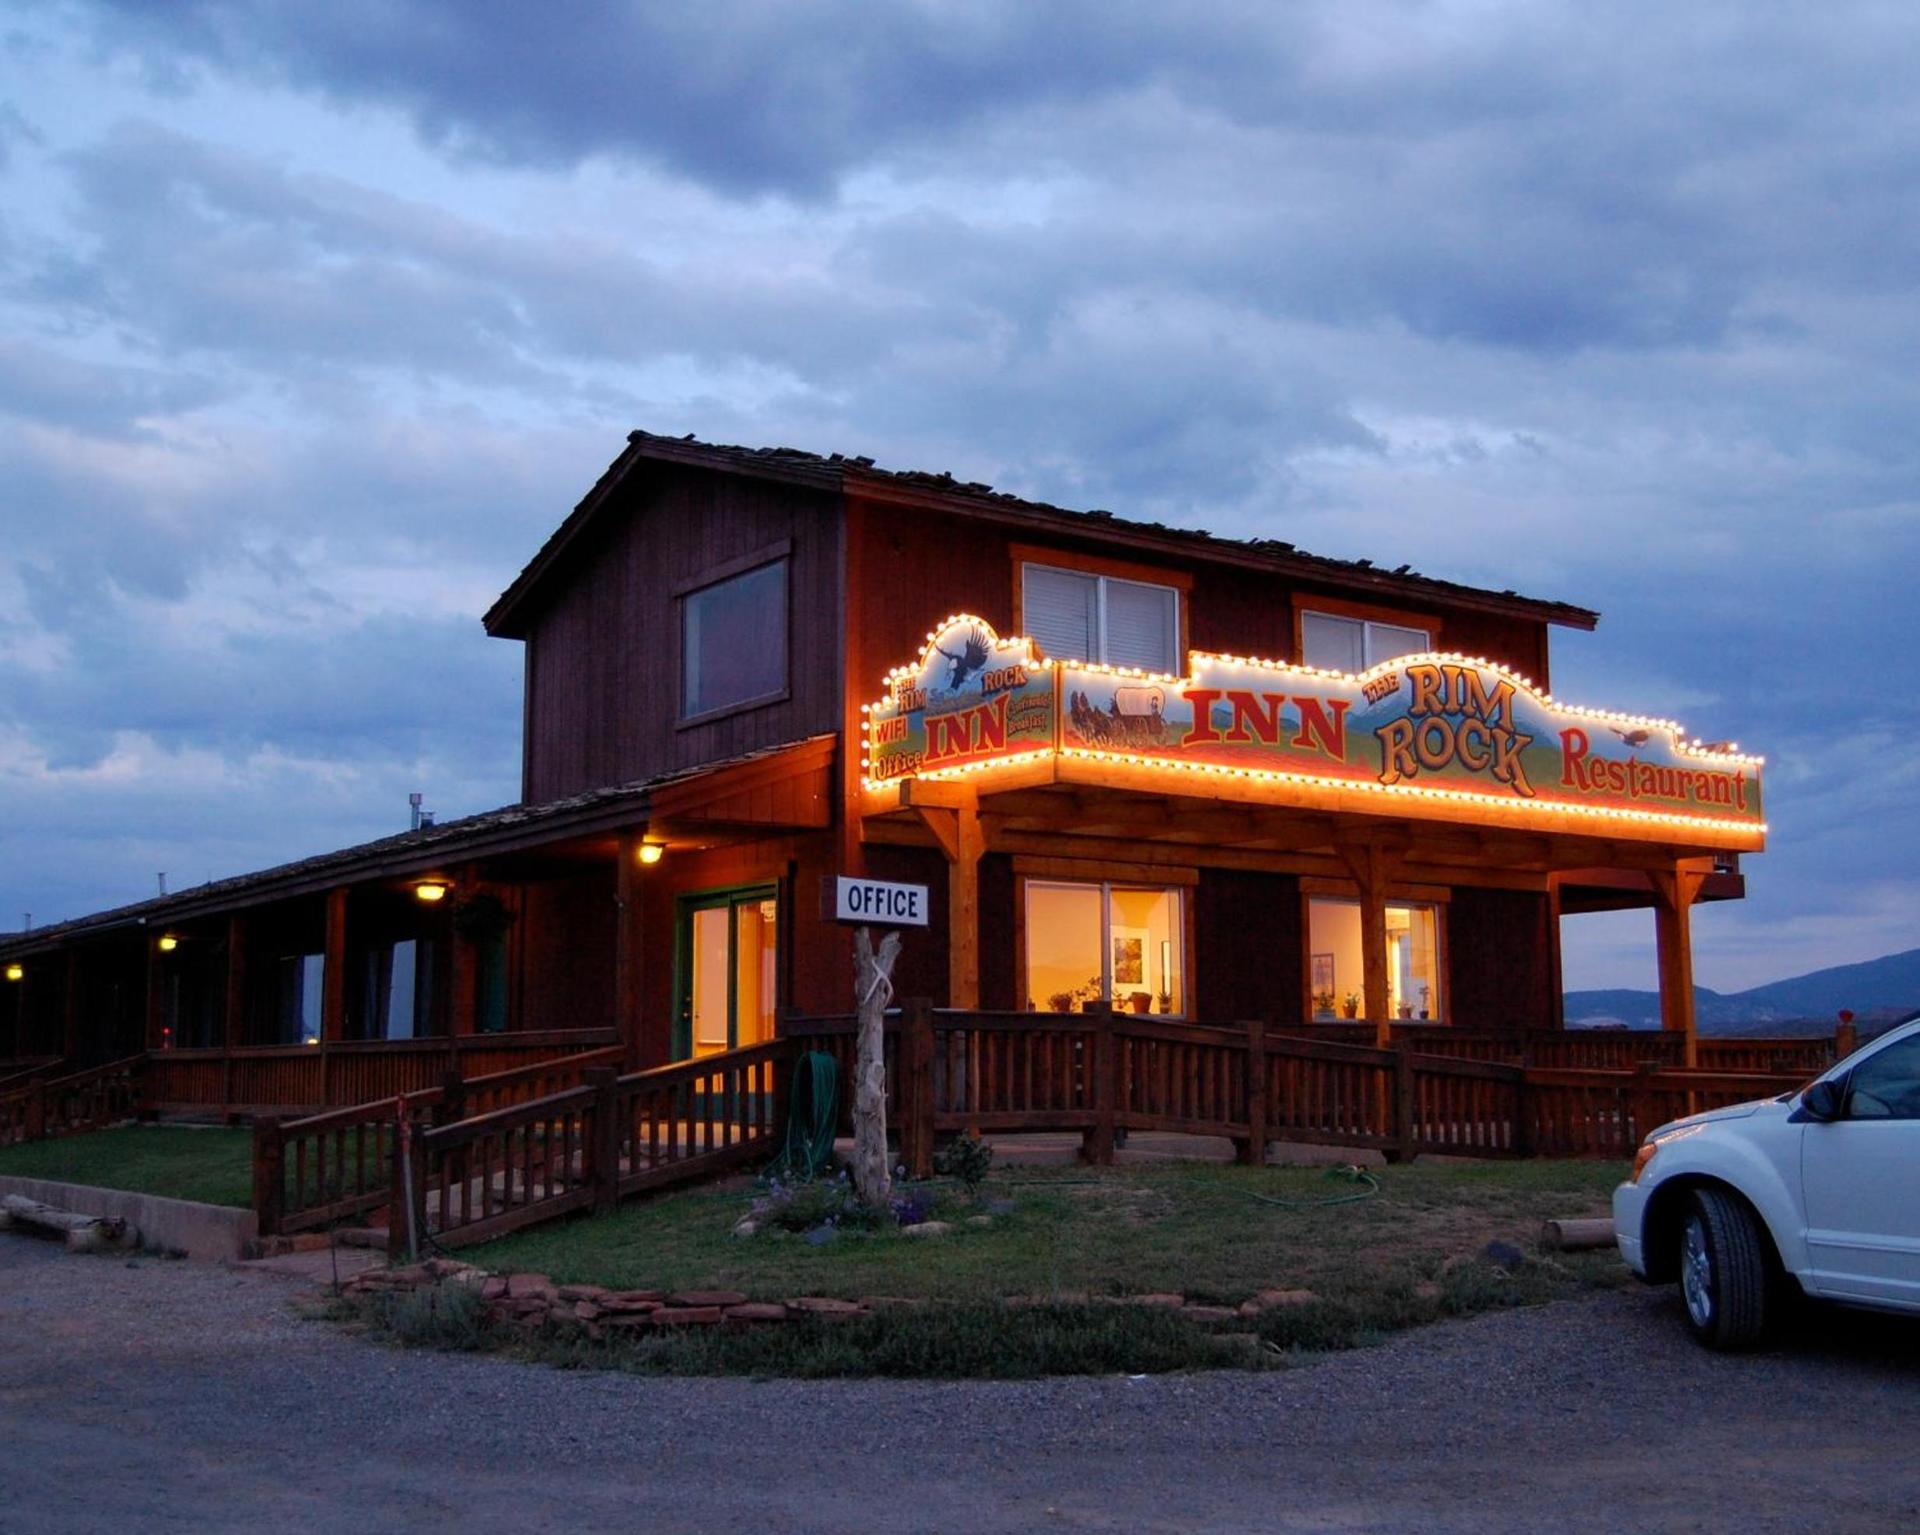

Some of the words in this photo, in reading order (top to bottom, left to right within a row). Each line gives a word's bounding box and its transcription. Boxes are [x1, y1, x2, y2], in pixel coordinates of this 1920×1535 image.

[898, 687, 928, 715] RIM
[983, 665, 1027, 694] ROCK
[1362, 672, 1399, 706] THE
[1405, 664, 1517, 734] RIM
[877, 719, 907, 743] WIFI
[923, 692, 1010, 763] INN
[1181, 688, 1352, 763] INN
[876, 751, 921, 779] Office
[1375, 716, 1536, 798] ROCK
[1558, 726, 1747, 812] Restaurant
[848, 885, 918, 917] OFFICE
